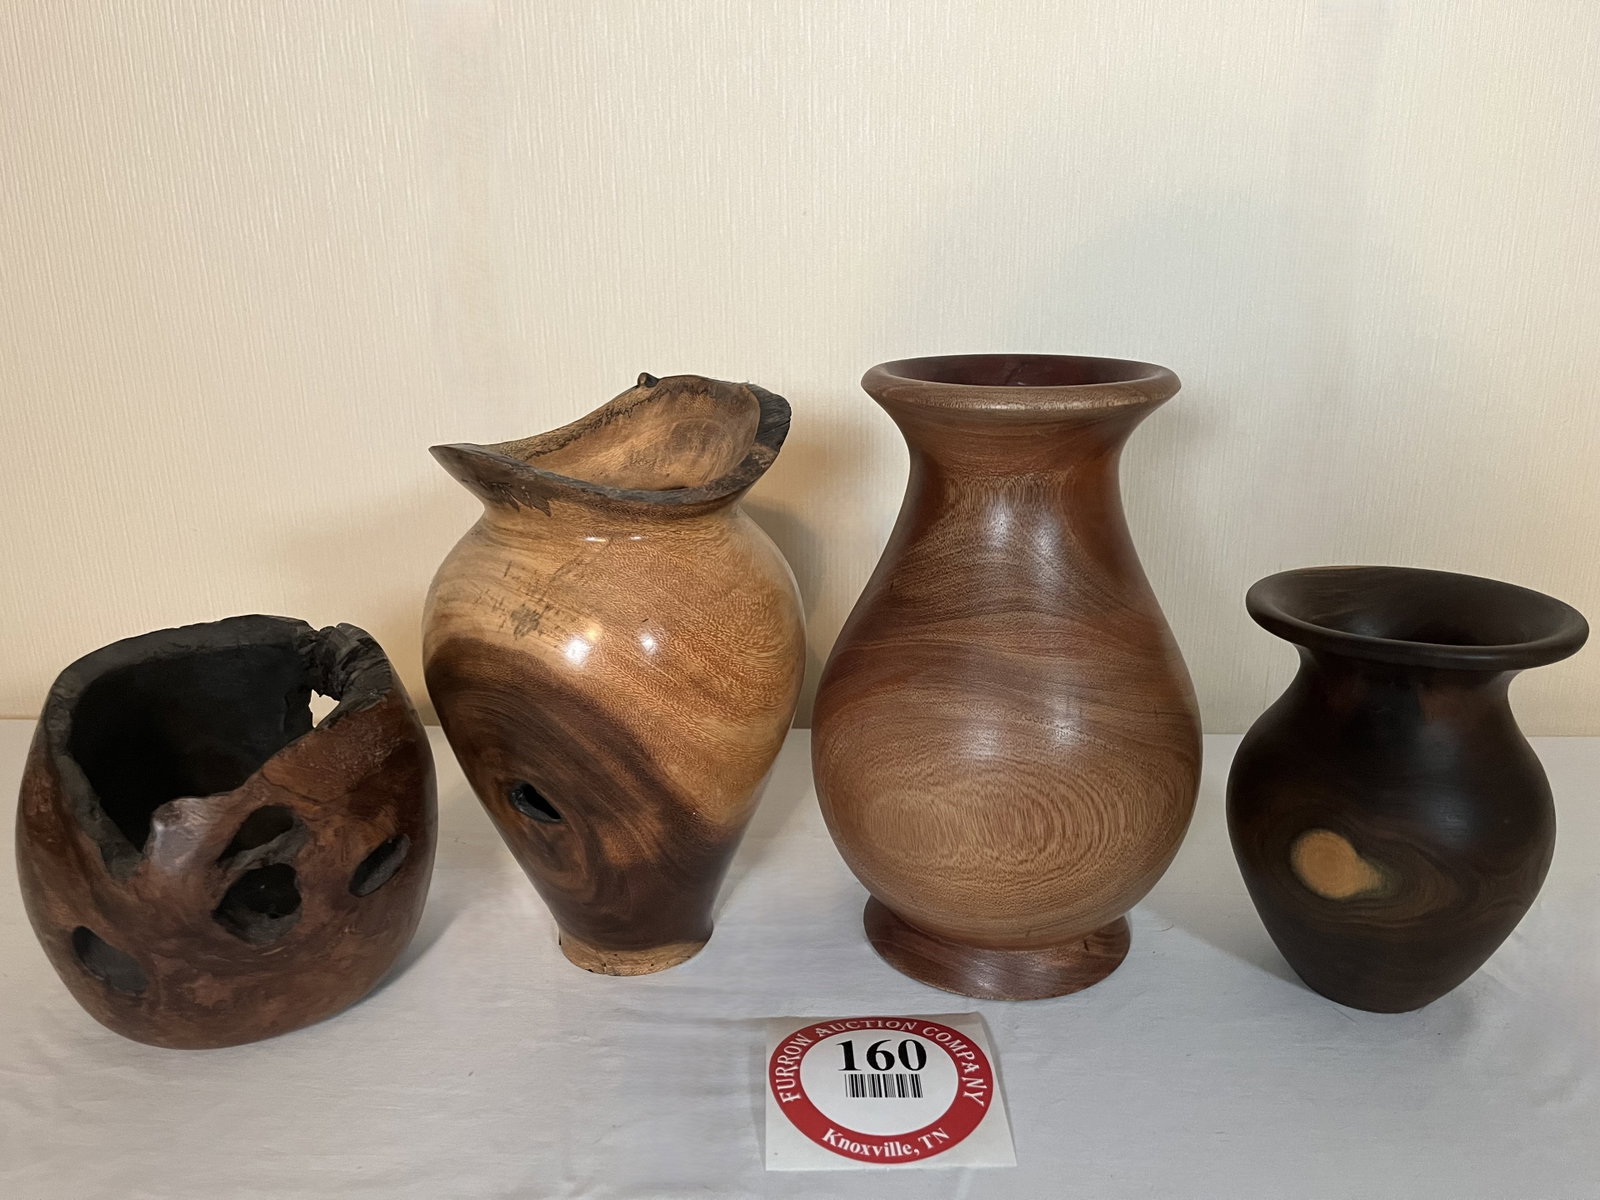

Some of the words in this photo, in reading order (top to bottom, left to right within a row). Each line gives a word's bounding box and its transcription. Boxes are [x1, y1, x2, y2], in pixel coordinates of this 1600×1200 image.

[775, 1034, 814, 1103] FURROW
[815, 1020, 917, 1037] AUCTION
[922, 1026, 988, 1106] COMPANY
[836, 1039, 927, 1072] 160
[822, 1128, 920, 1157] Knoxville,
[918, 1128, 951, 1150] TN
